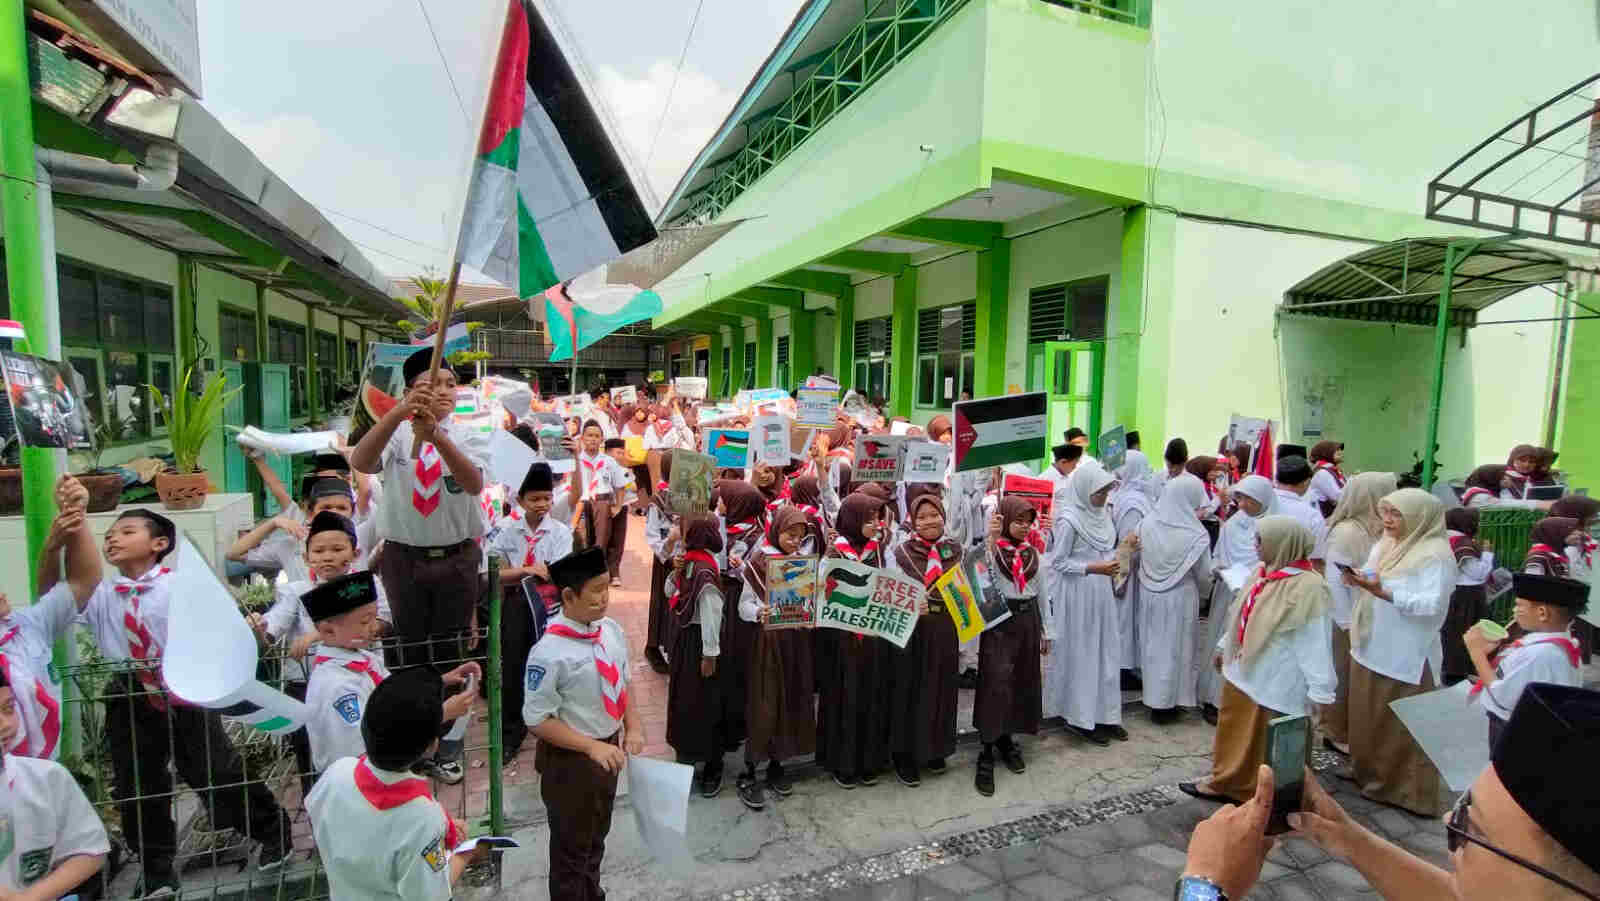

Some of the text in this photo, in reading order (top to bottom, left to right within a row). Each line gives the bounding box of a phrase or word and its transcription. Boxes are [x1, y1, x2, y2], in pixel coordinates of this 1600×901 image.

[857, 458, 896, 469] #SAVE
[876, 575, 919, 599] FREE
[872, 590, 915, 612] GAZA
[821, 606, 906, 639] PALESTINE
[867, 604, 910, 625] FREE
